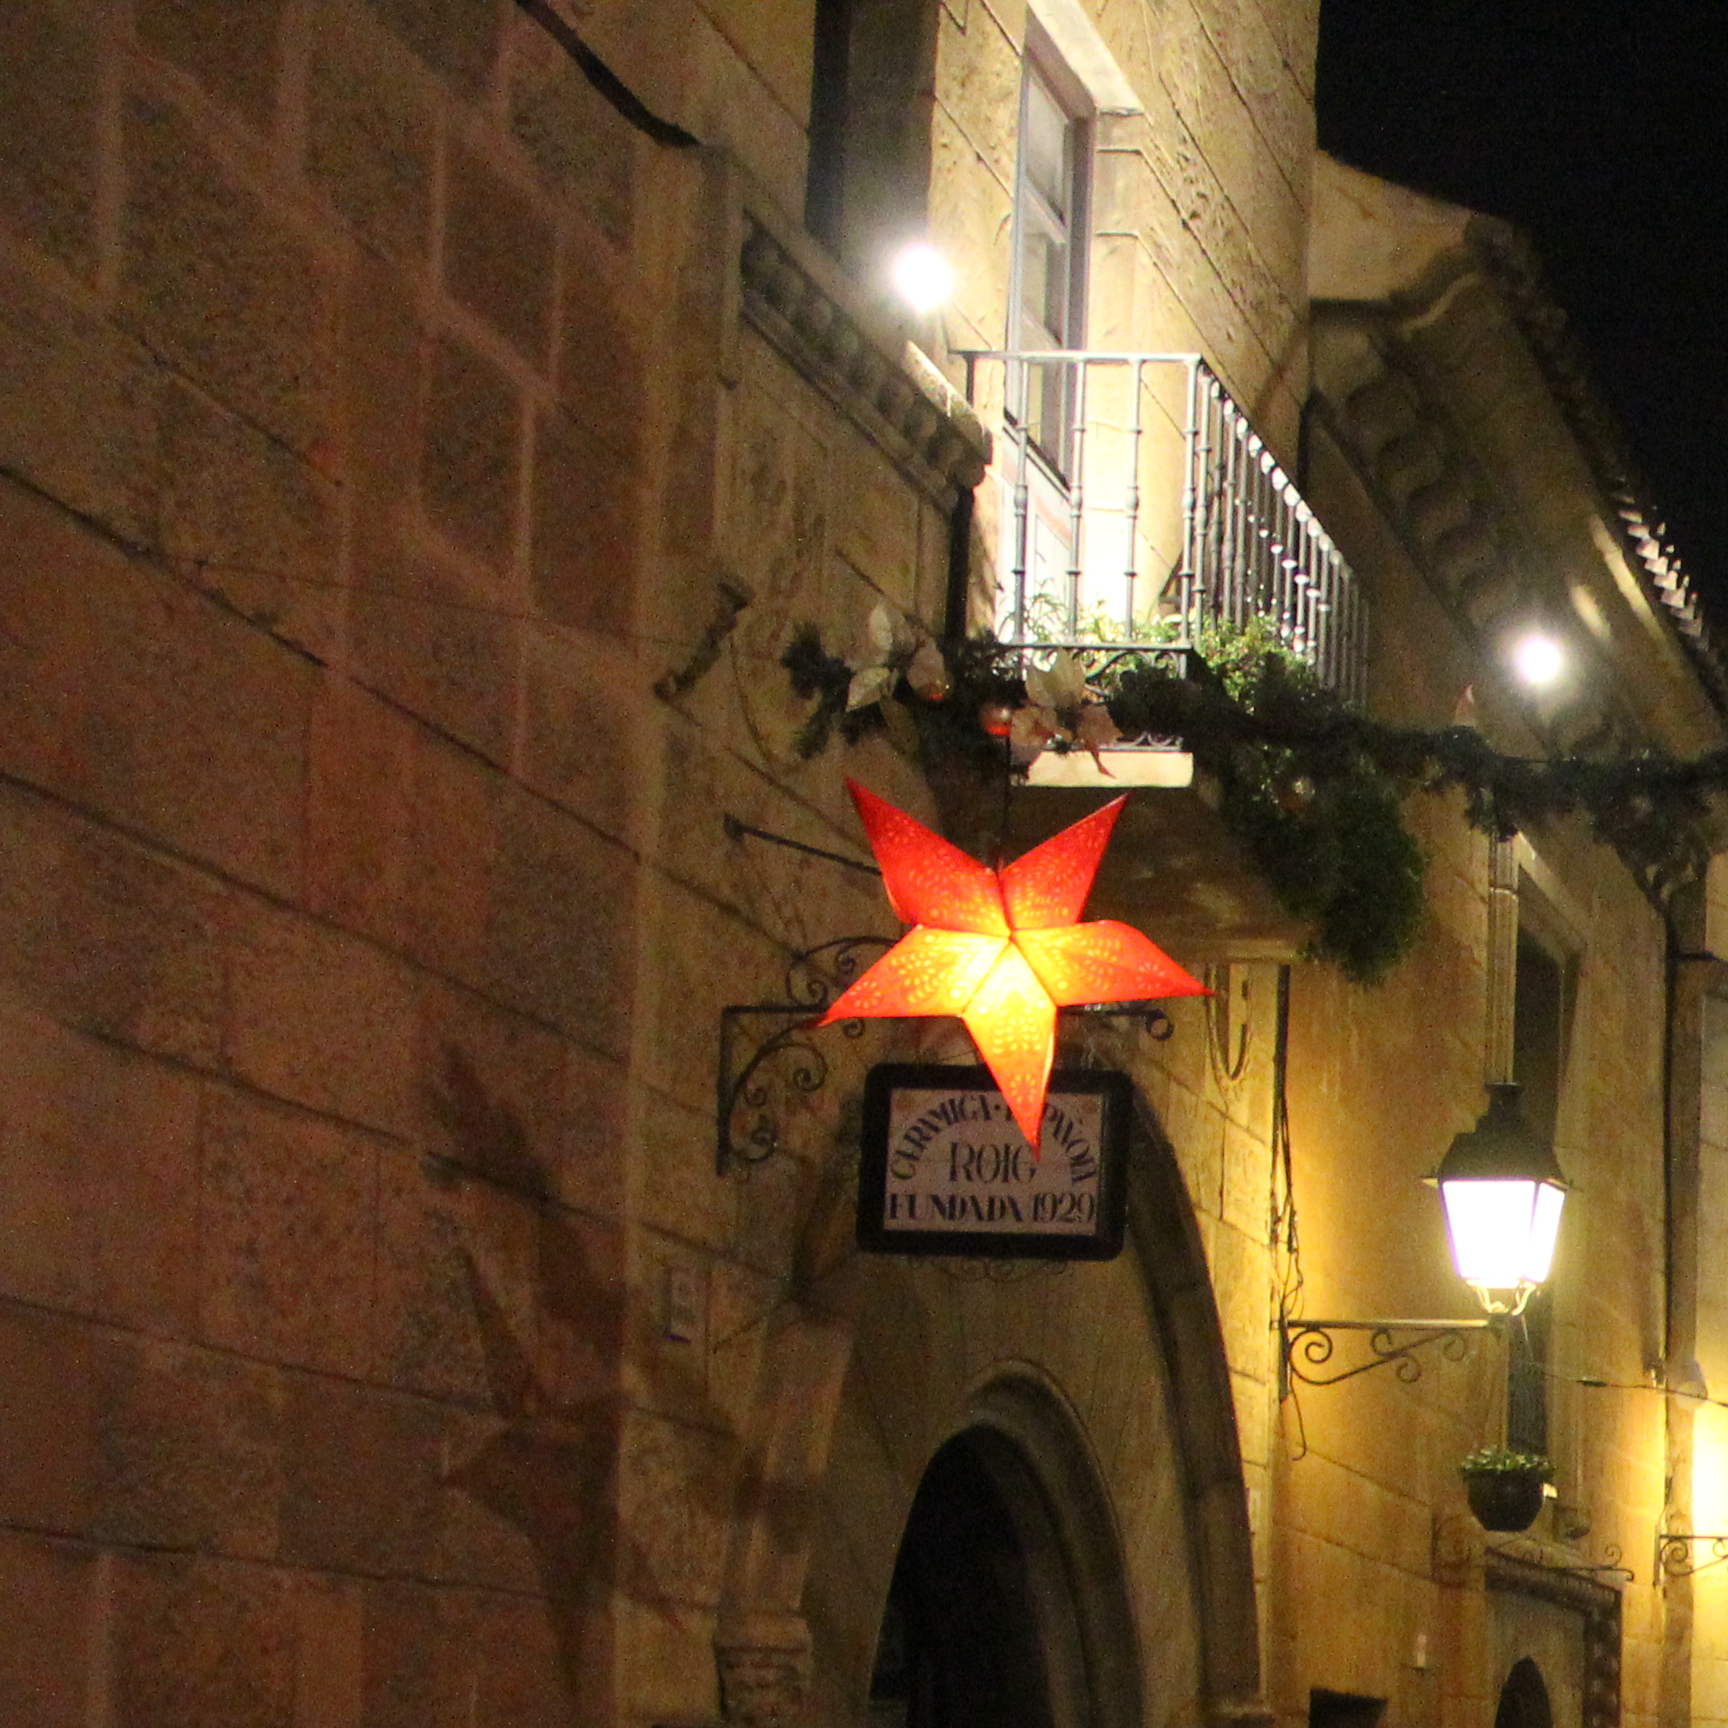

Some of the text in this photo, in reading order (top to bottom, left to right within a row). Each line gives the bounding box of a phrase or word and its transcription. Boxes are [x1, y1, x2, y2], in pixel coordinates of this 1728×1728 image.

[948, 1141, 1037, 1184] ROIG
[888, 1192, 1096, 1223] FUNDADA 1929
